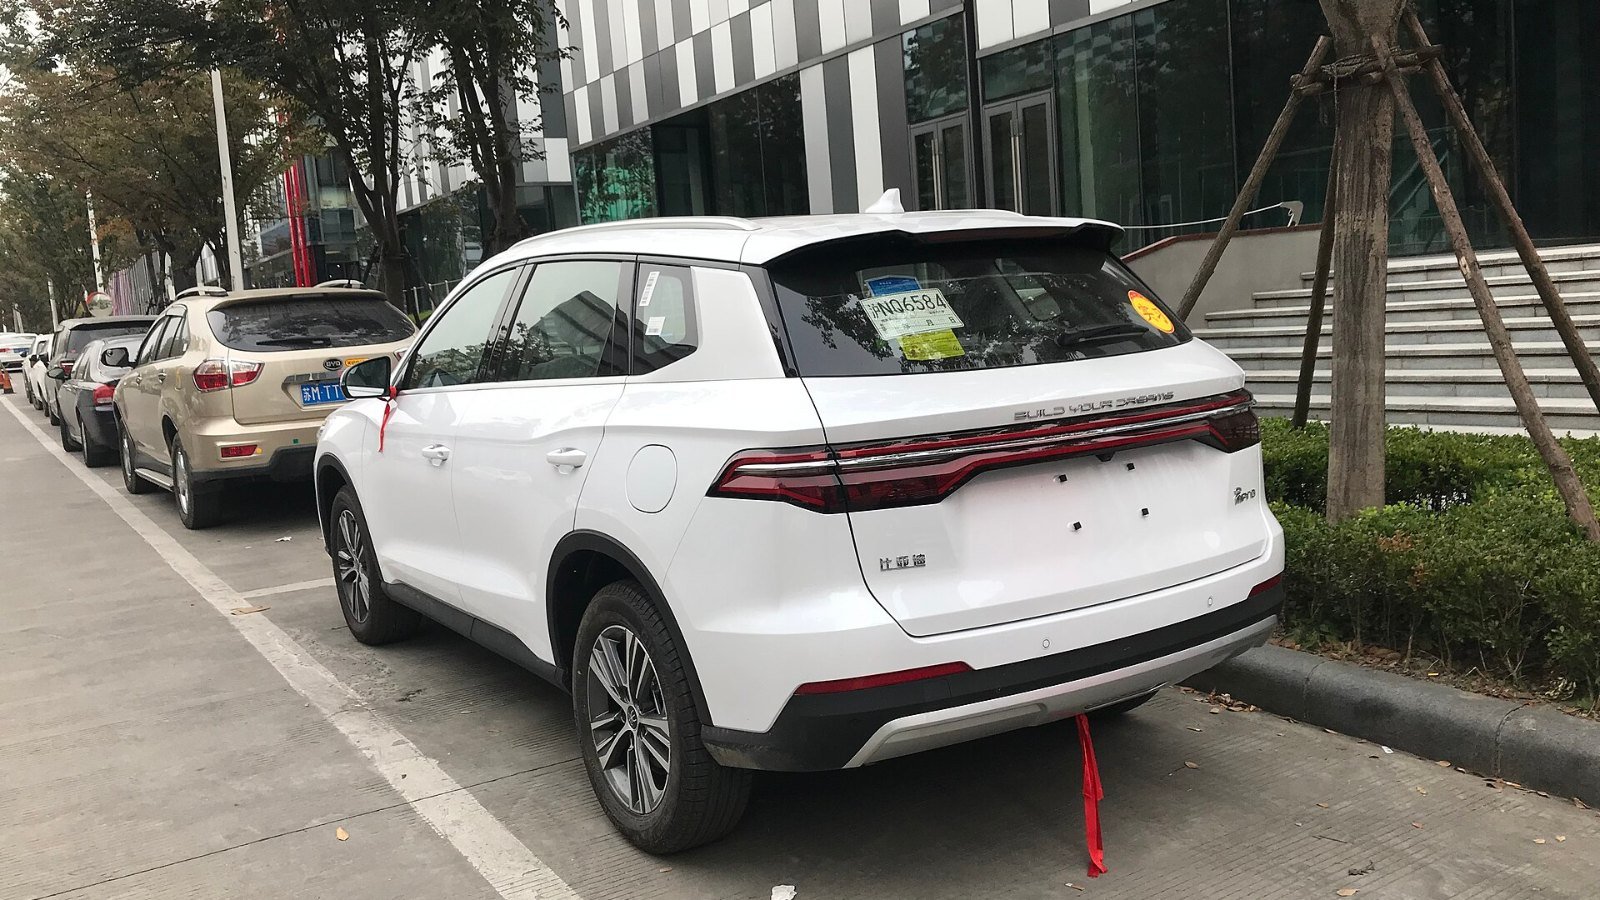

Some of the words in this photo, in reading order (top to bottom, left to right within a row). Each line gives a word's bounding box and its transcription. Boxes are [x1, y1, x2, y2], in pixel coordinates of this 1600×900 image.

[868, 293, 947, 318] 沪NQ6584
[301, 385, 342, 401] 苏M·TT
[1014, 406, 1066, 421] BUILD
[1069, 400, 1113, 415] YOUR
[1115, 391, 1175, 408] DREAMS
